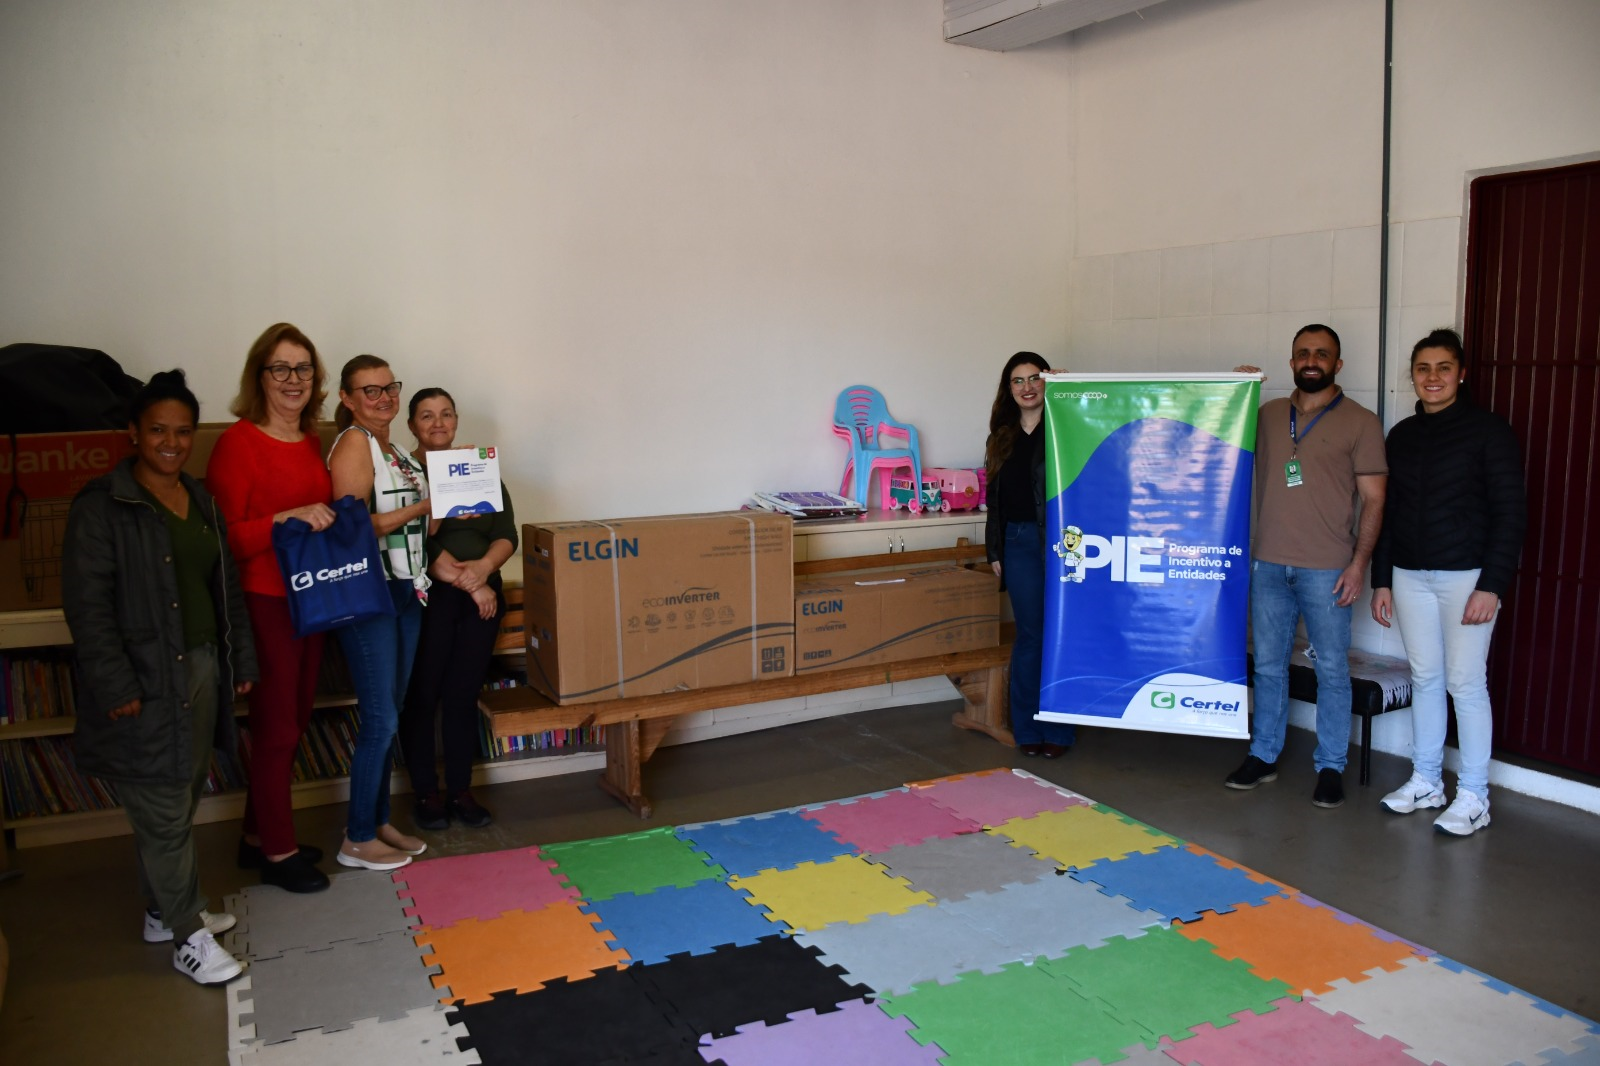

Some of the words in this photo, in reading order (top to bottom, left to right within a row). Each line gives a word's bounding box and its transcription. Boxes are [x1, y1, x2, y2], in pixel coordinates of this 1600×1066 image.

[449, 463, 470, 477] PIE
[568, 537, 639, 562] ELGIN
[1168, 543, 1227, 556] Programa
[1228, 545, 1243, 556] de
[1082, 534, 1165, 584] PIE
[1168, 556, 1223, 568] Incentivo
[1224, 560, 1231, 568] a
[316, 558, 368, 581] Certel
[1168, 569, 1226, 581] Entidades
[802, 599, 843, 616] ELGIN
[1180, 697, 1240, 712] Certel
